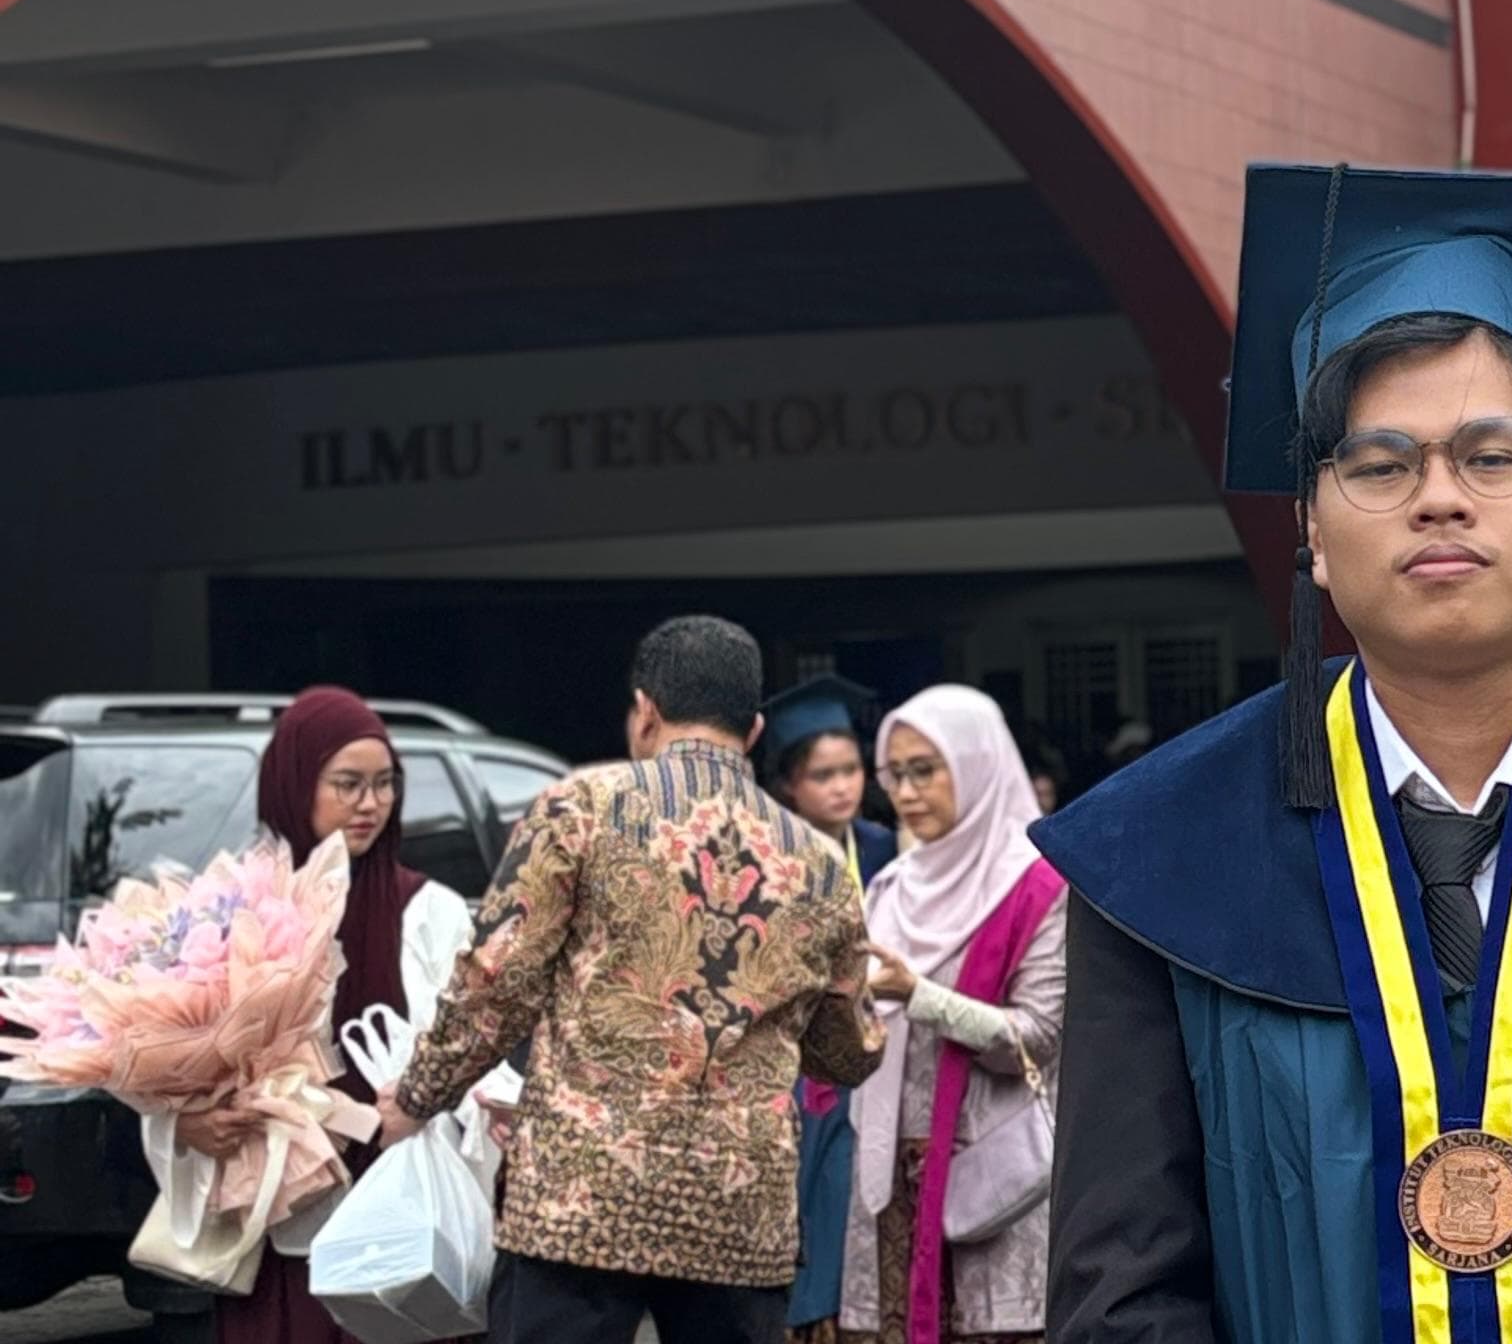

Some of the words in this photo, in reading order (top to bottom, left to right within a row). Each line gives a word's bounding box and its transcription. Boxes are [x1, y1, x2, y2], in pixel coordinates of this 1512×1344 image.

[299, 421, 485, 490] ILMU
[537, 384, 1032, 473] TEKNOLOGI
[1402, 1157, 1429, 1233] INSTITUT
[1426, 1244, 1501, 1267] SARJANA
